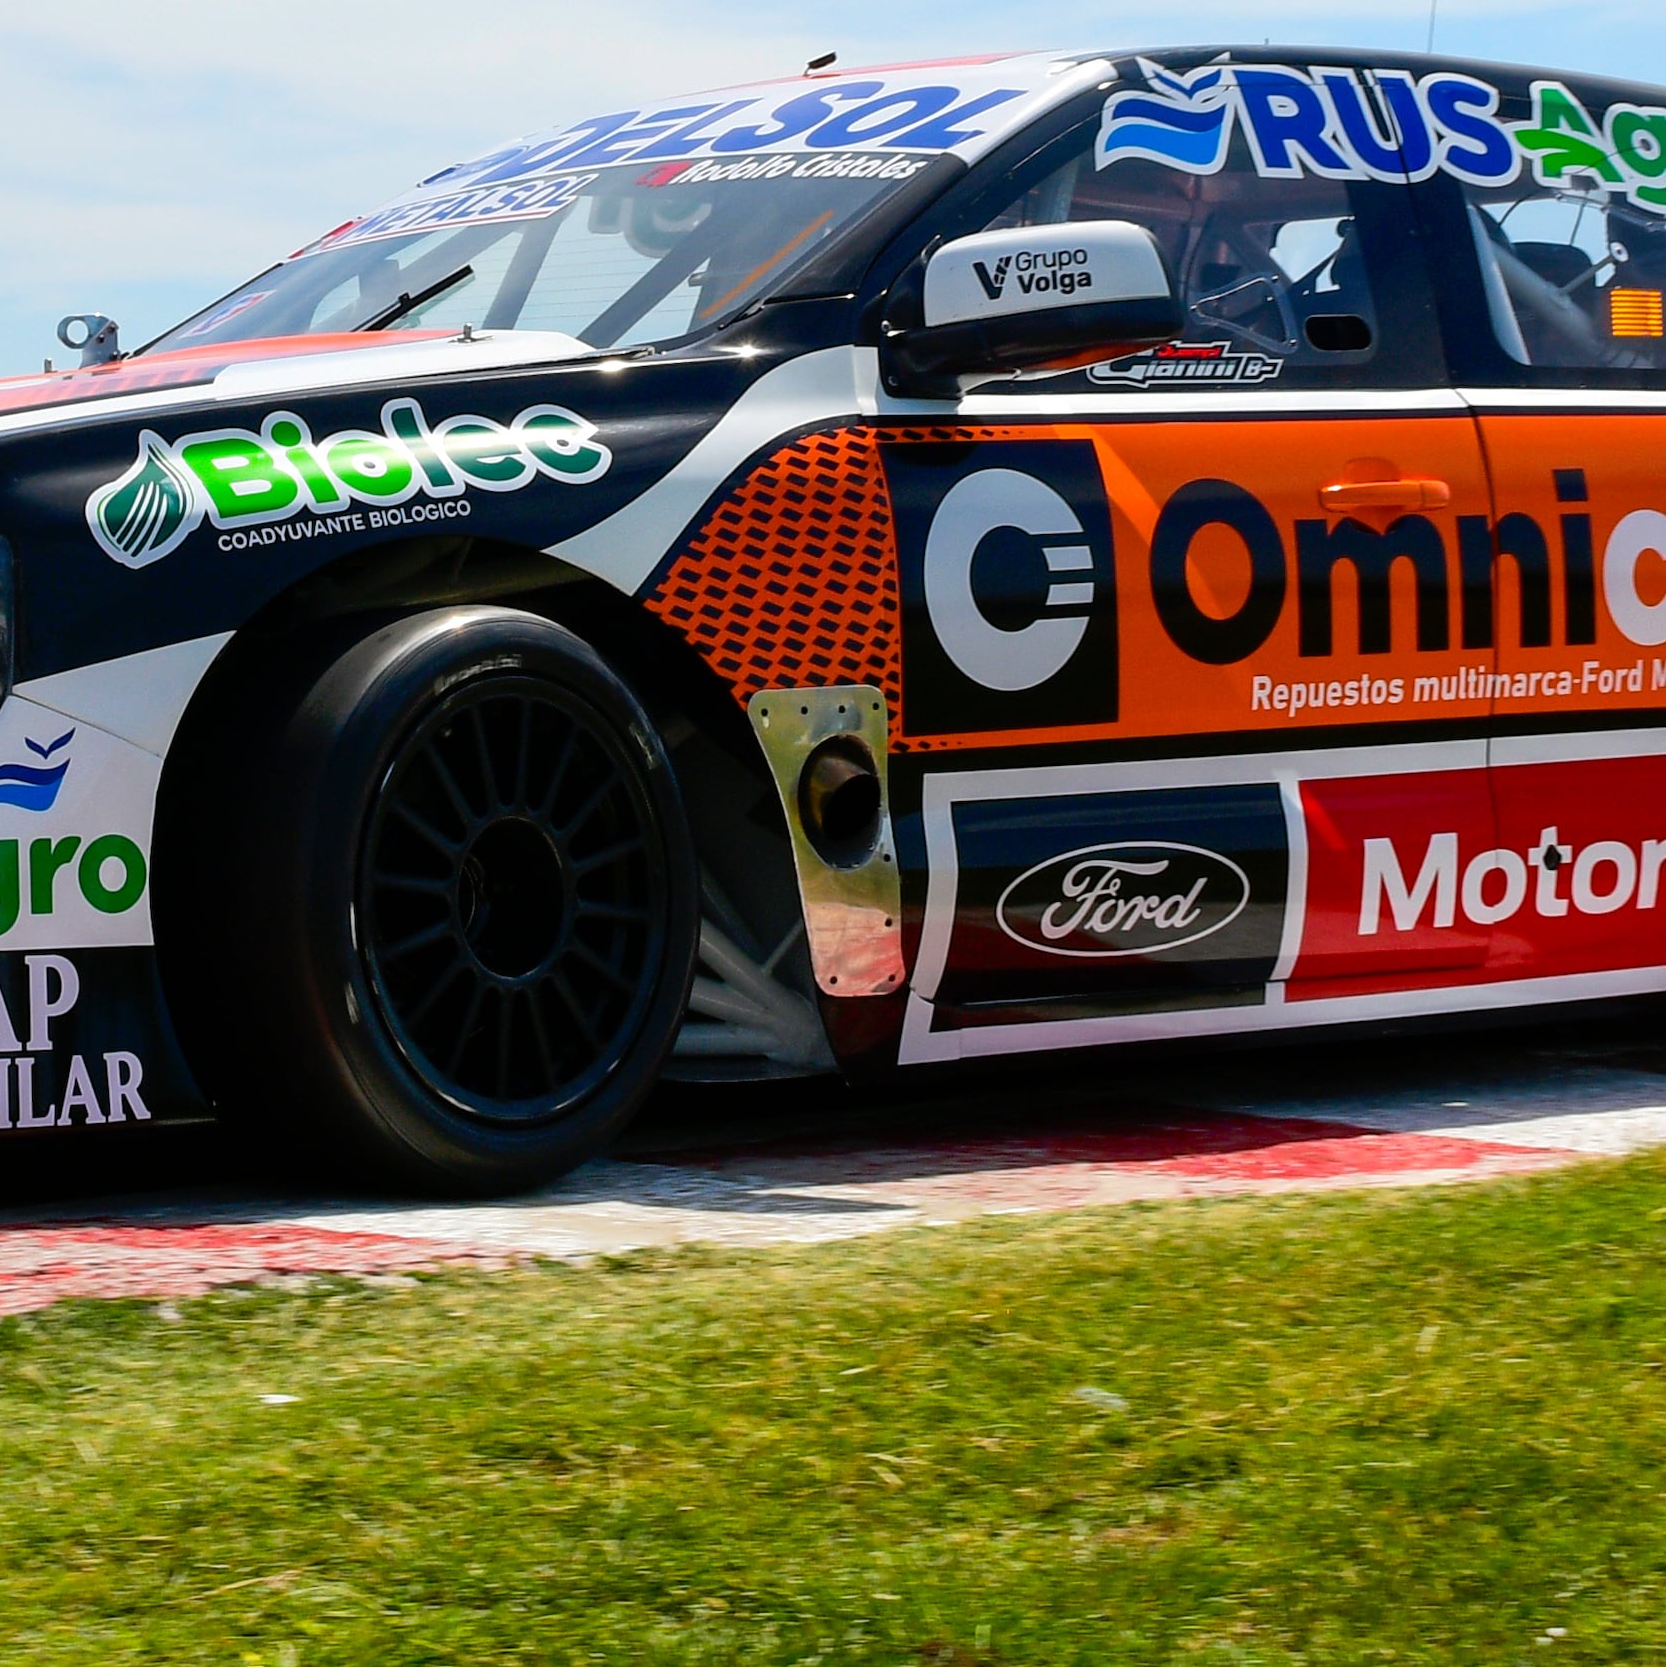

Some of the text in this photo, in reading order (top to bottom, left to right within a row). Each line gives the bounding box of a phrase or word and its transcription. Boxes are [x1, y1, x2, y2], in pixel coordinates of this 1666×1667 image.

[668, 152, 929, 186] Rodolfo Cristales
[1015, 248, 1088, 272] Grupo
[1017, 271, 1093, 295] Volga
[178, 400, 612, 526] Biolec
[217, 499, 472, 553] COADYUVANTE BIOLOGICO
[1250, 673, 1404, 718] Repuestos
[1413, 660, 1643, 703] multimarca-Ford
[1040, 856, 1211, 940] Ford
